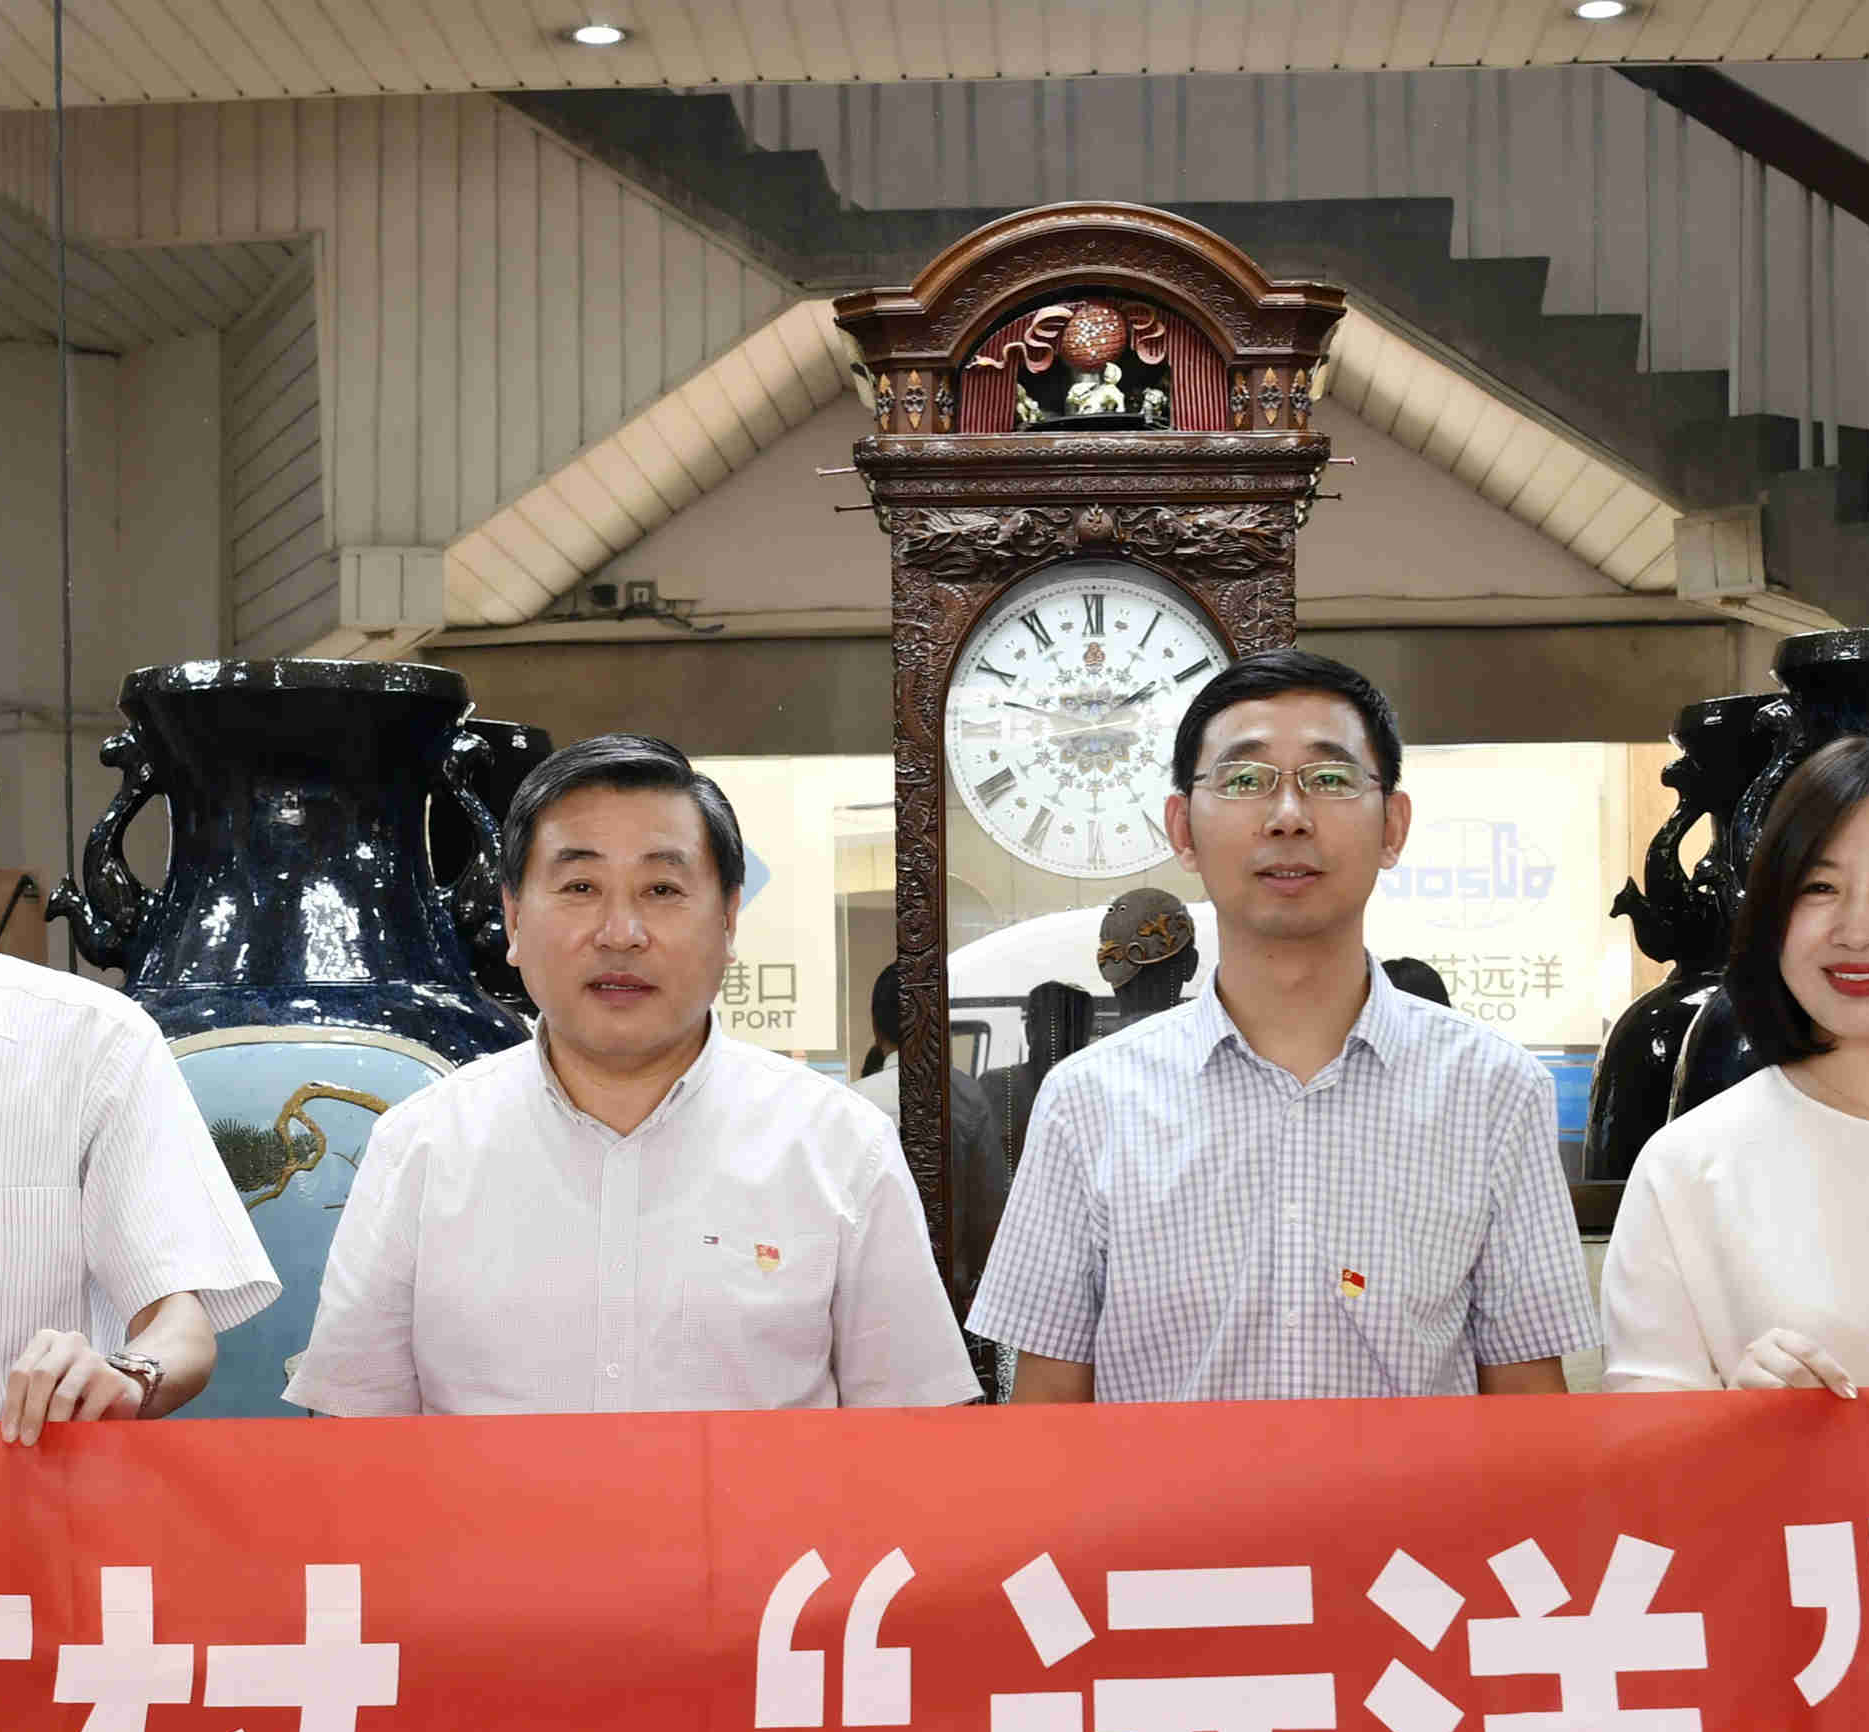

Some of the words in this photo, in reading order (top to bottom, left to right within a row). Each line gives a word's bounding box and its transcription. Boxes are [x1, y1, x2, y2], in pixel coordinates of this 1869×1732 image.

[1082, 593, 1106, 638] XII
[1428, 953, 1564, 999] 苏远洋
[731, 1010, 797, 1029] PORT
[1456, 1002, 1517, 1022] SCO
